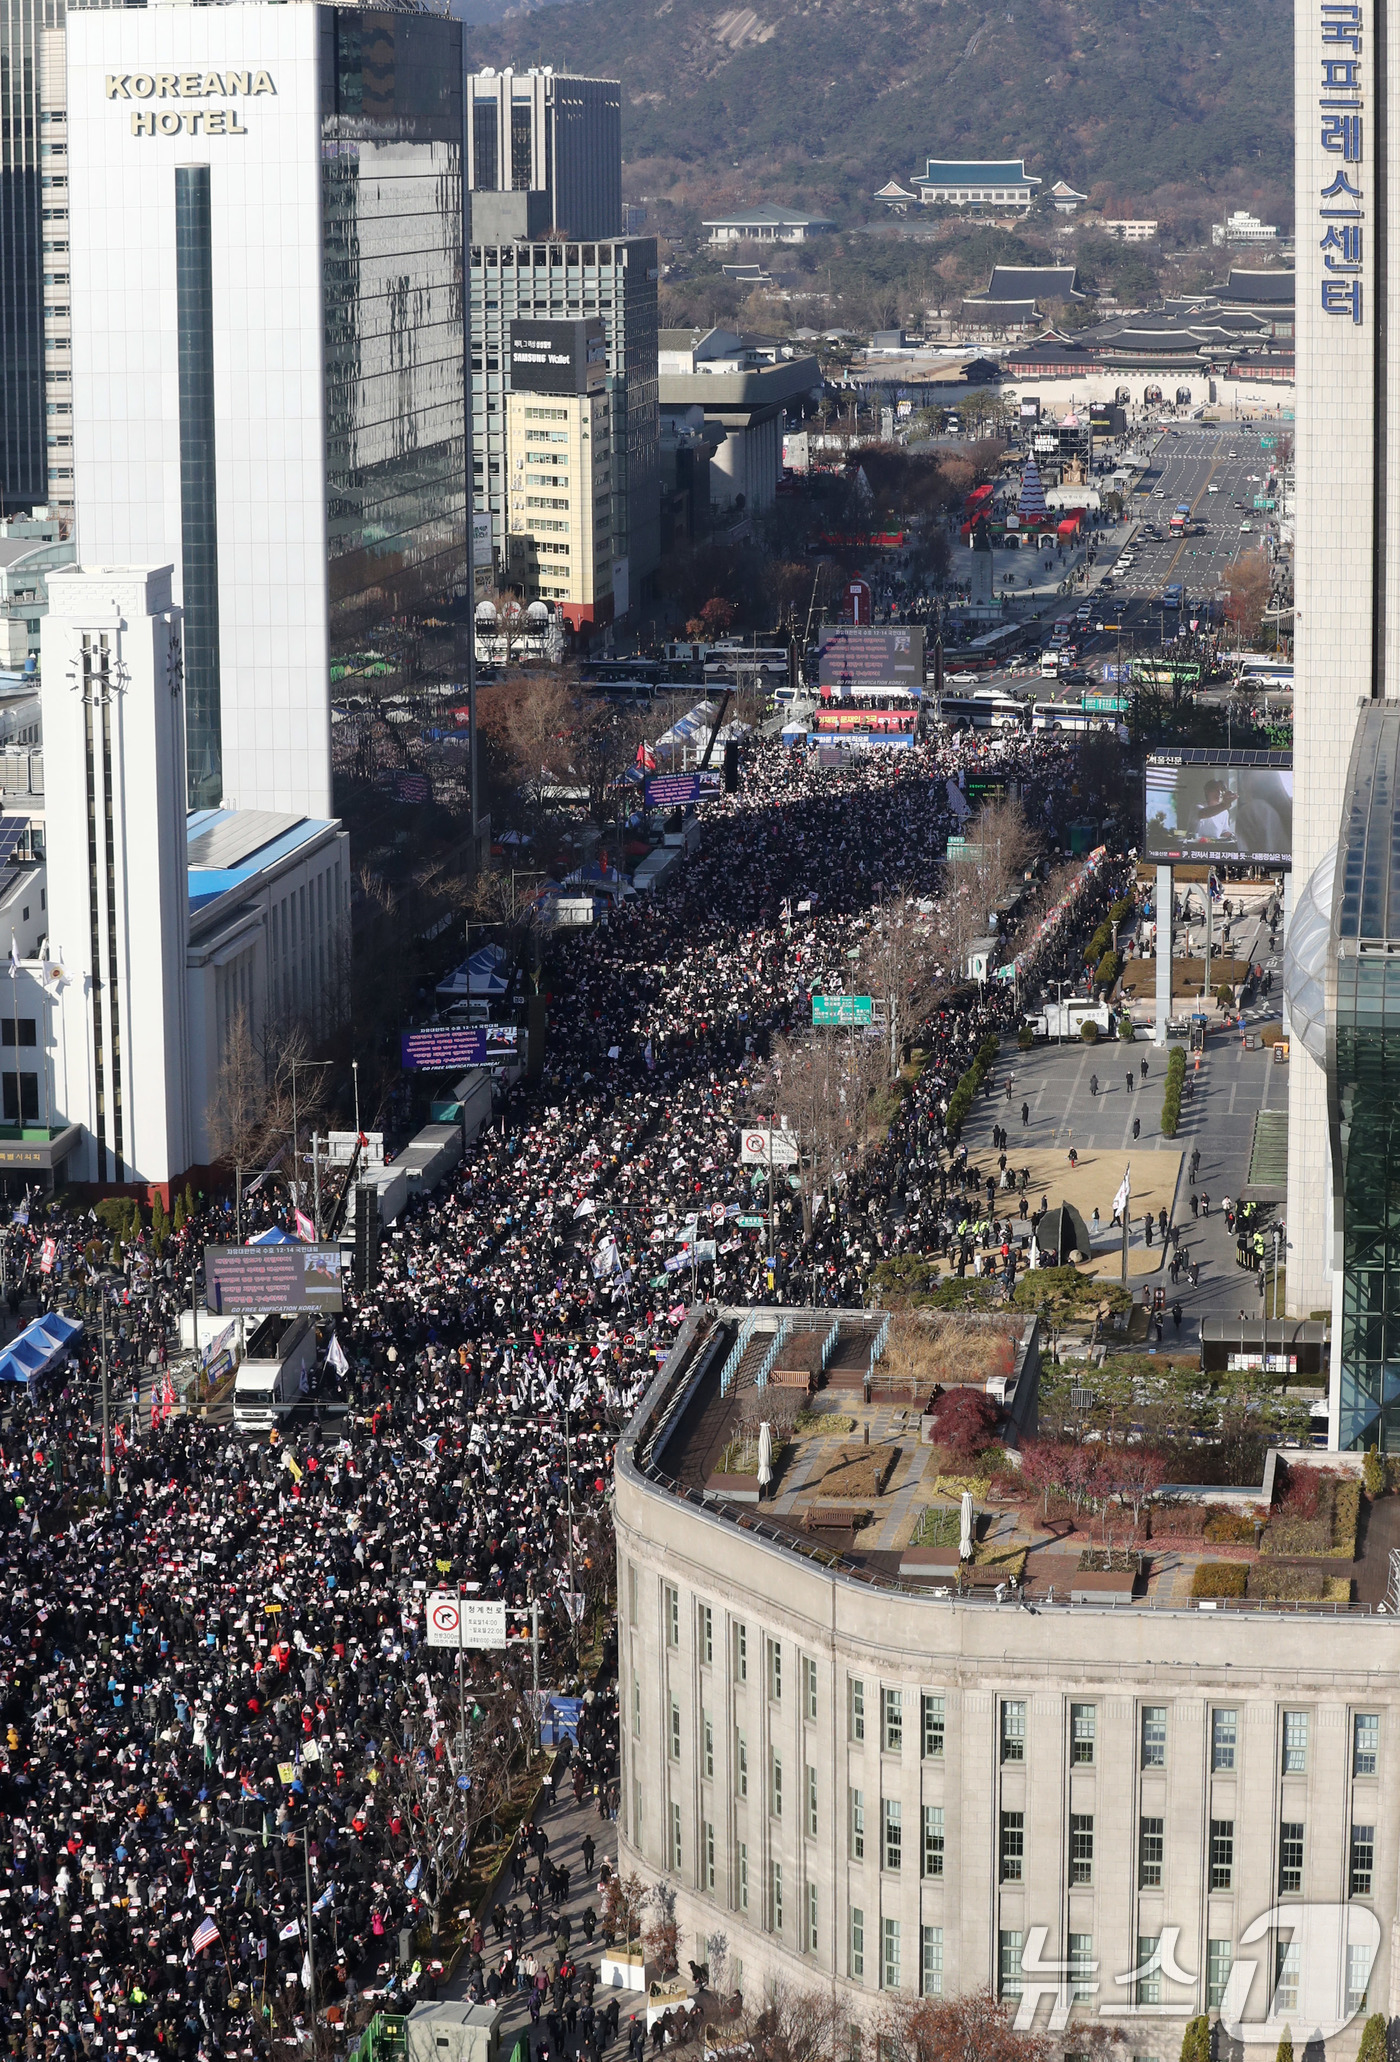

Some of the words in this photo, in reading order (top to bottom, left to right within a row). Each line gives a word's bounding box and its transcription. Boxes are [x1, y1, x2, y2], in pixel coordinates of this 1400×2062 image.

[104, 69, 278, 100] KOREANA
[130, 109, 248, 137] HOTEL
[513, 353, 546, 363] SAMSUNG
[548, 354, 571, 364] Wallet
[1149, 756, 1182, 765] 서울신문
